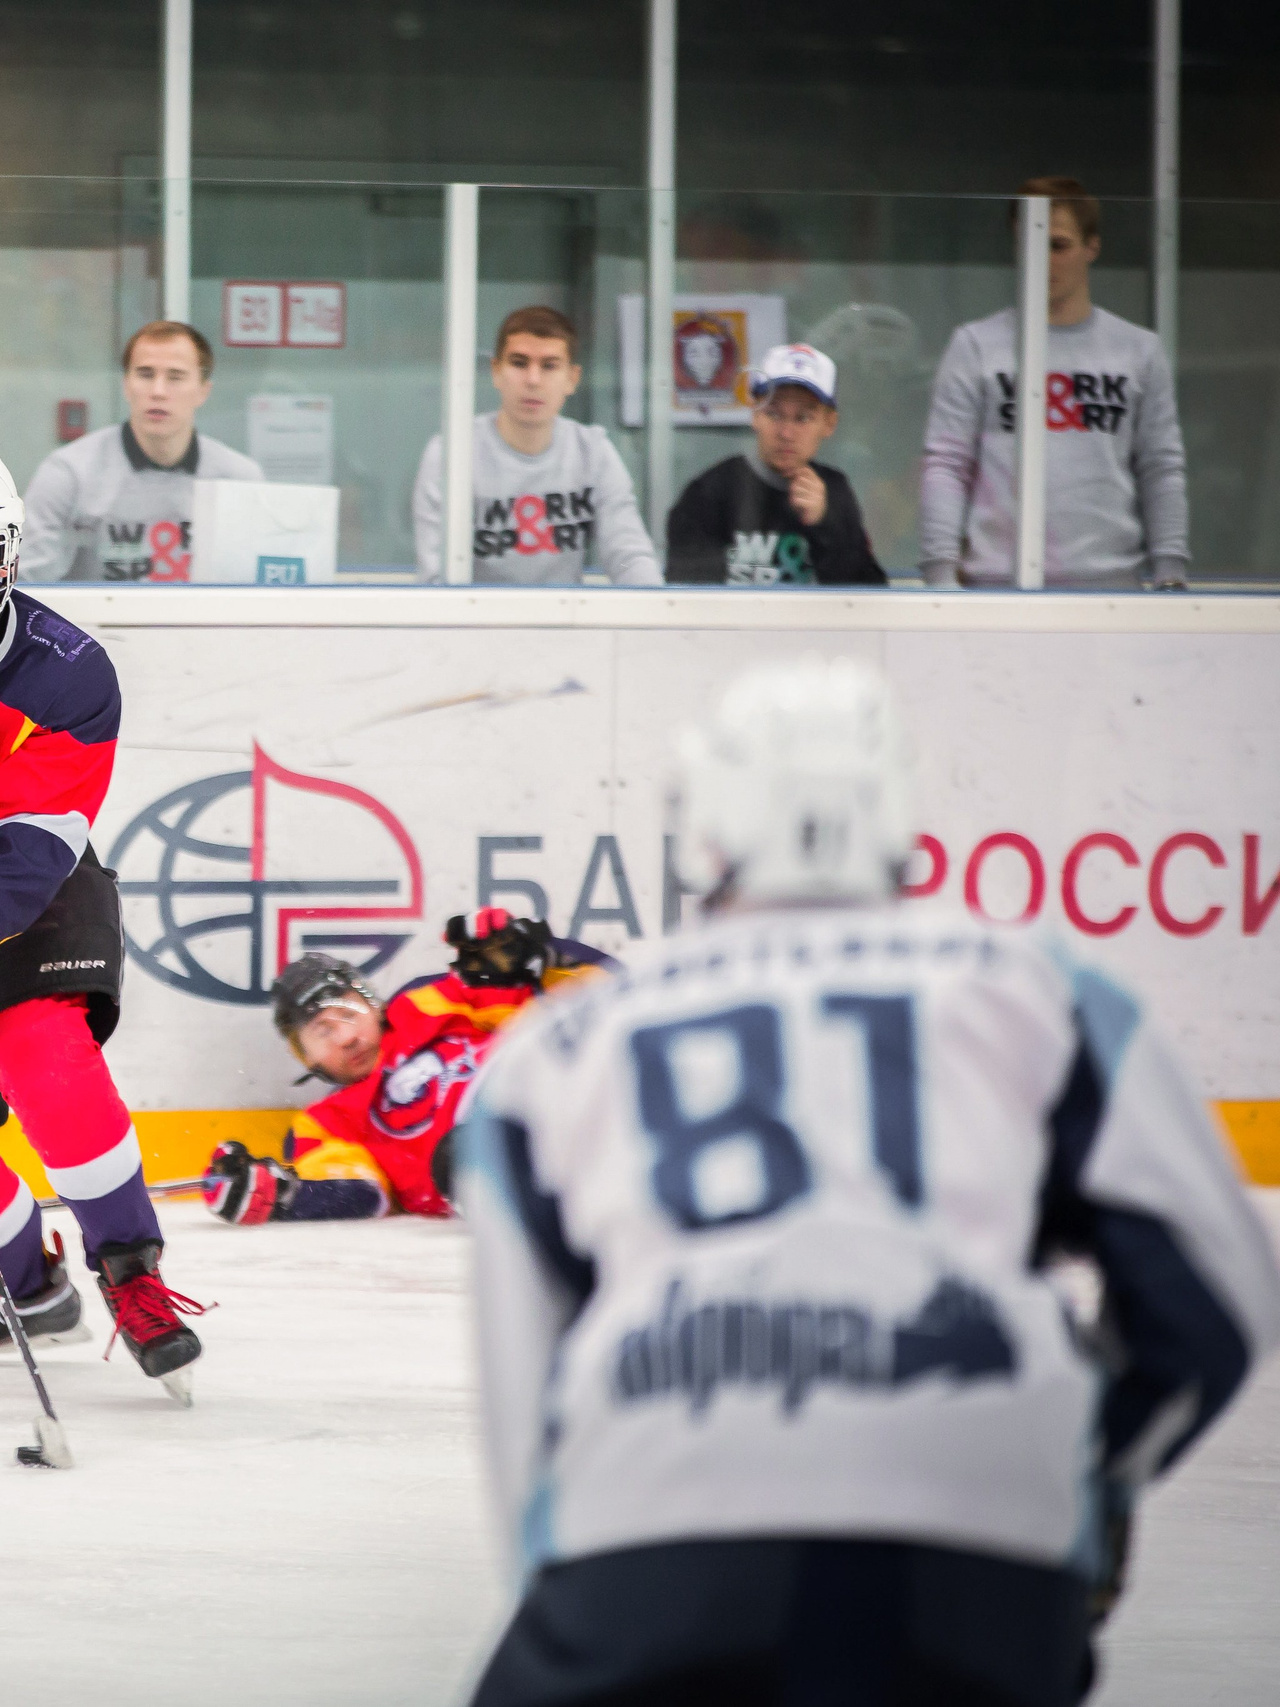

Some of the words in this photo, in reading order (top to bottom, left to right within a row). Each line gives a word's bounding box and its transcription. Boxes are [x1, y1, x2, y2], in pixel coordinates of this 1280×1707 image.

[477, 835, 705, 939] БАН
[39, 960, 106, 973] BAUER
[628, 992, 924, 1232] 81
